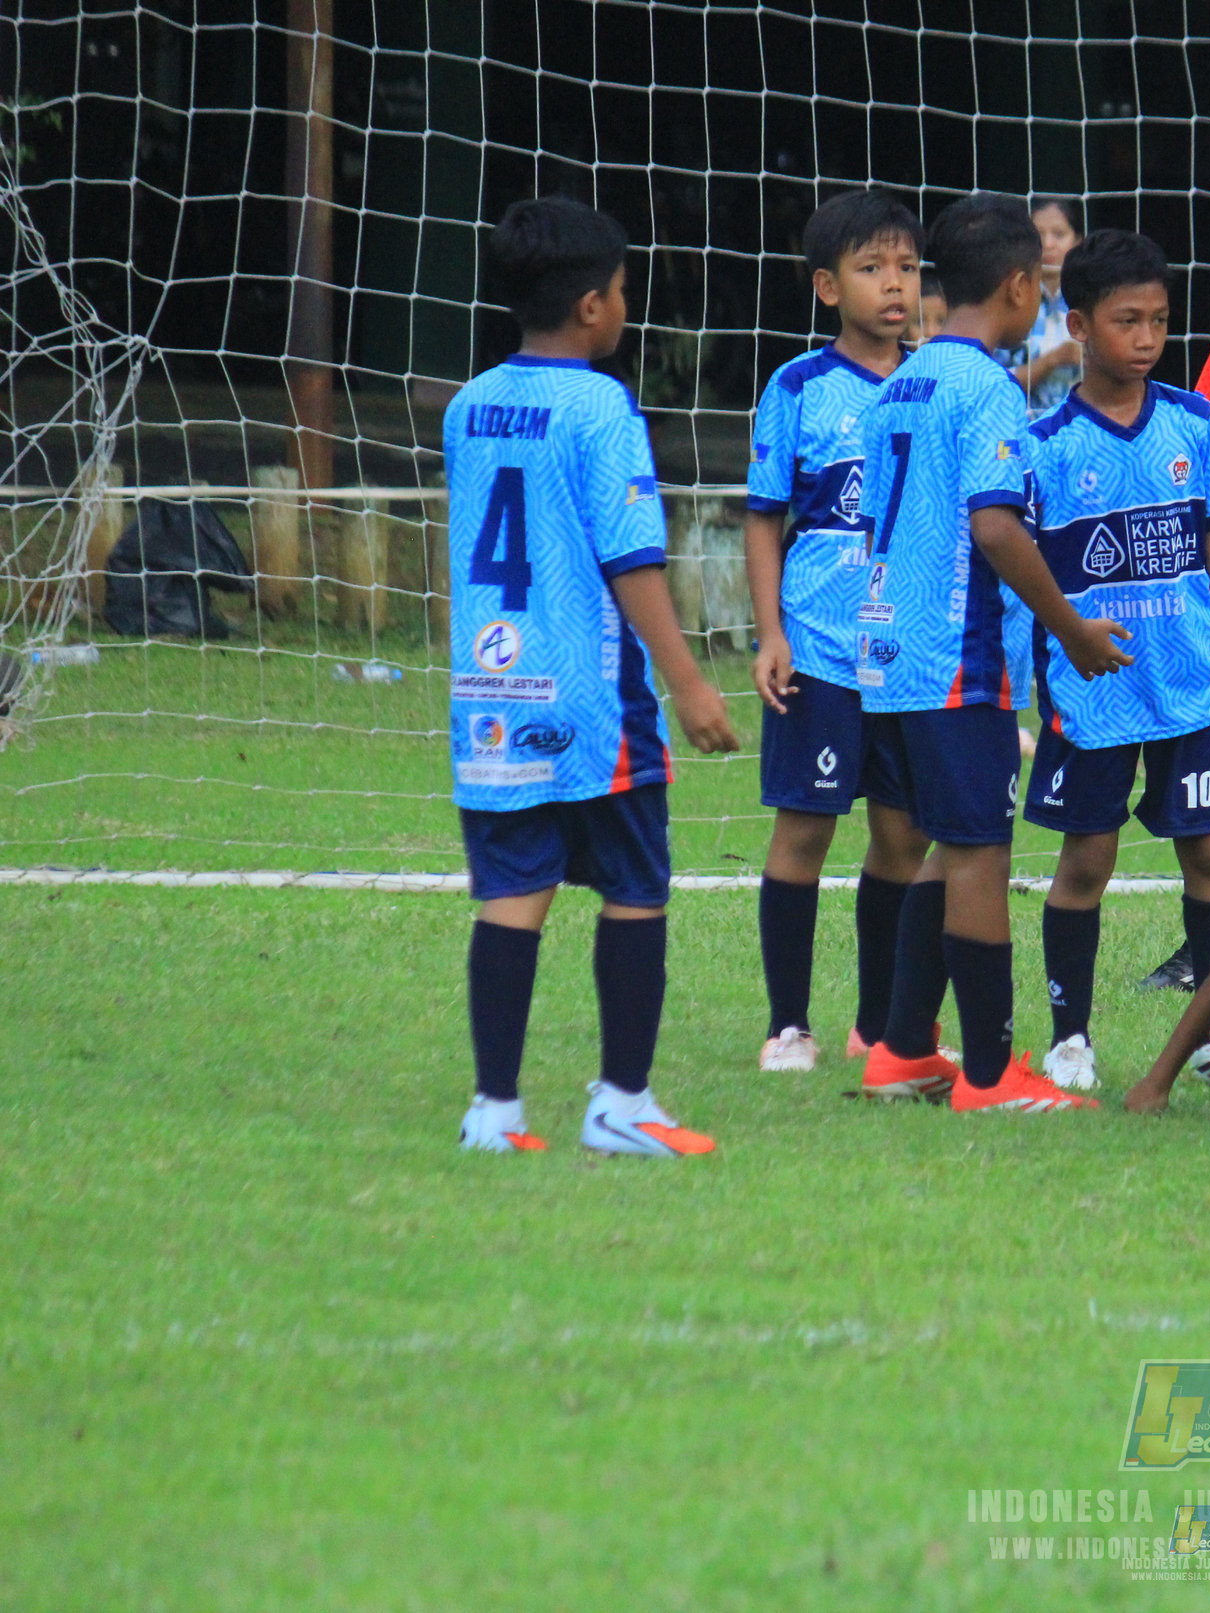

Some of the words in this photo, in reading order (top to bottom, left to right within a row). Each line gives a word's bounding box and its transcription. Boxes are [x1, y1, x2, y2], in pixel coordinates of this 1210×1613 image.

[876, 432, 912, 554] 7
[468, 467, 532, 612] 4
[1131, 516, 1183, 540] KARYA
[601, 642, 620, 682] SSB
[814, 779, 838, 788] Güzel
